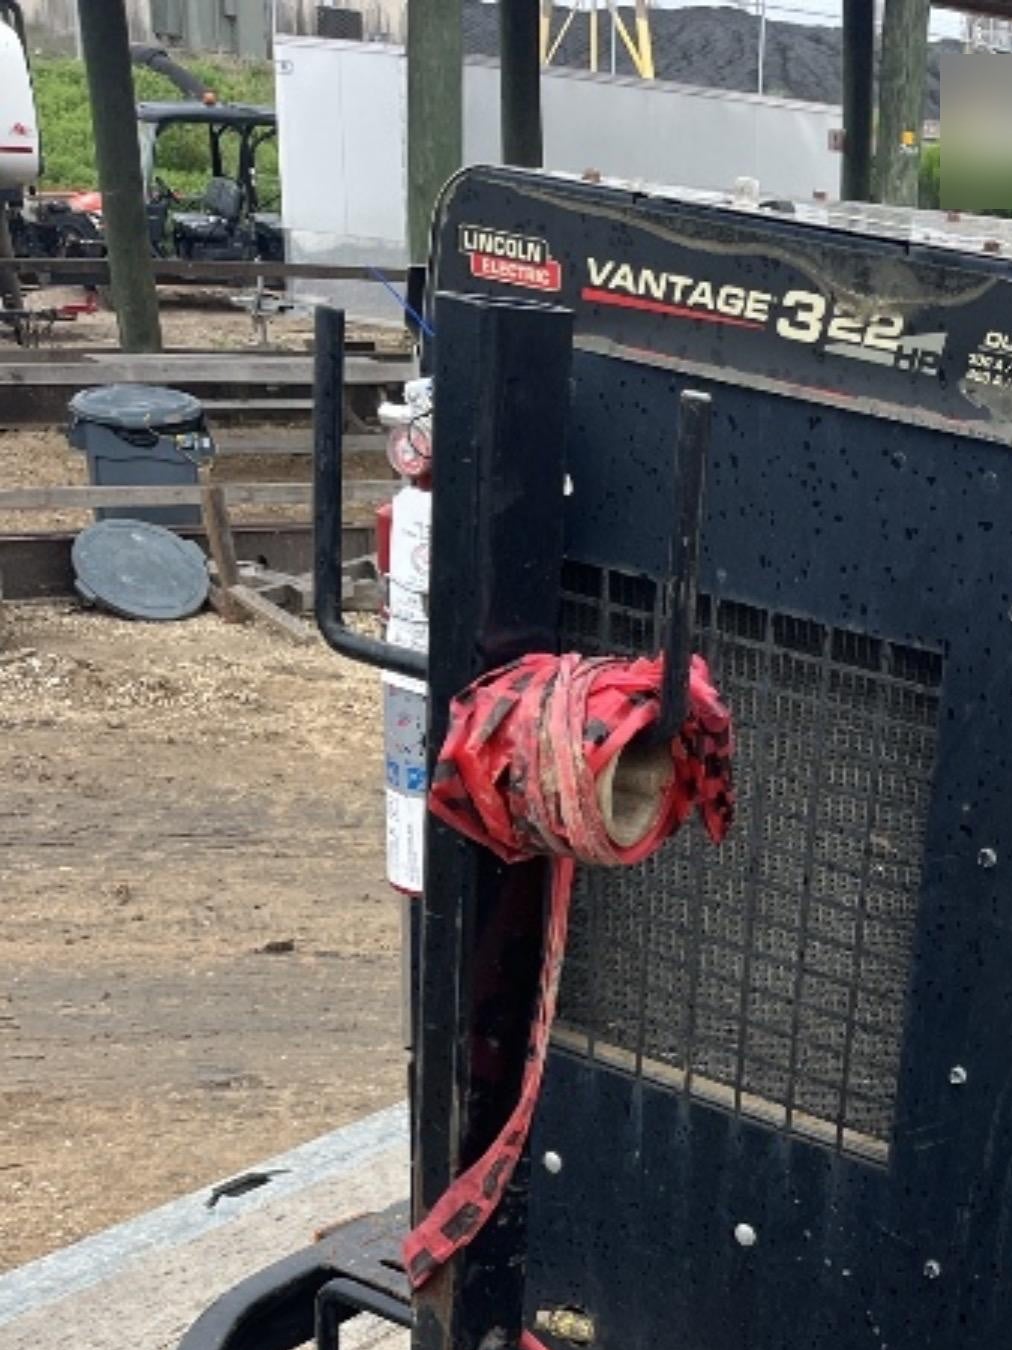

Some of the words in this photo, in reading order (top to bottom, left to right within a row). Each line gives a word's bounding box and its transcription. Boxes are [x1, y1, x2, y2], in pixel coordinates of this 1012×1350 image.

[463, 230, 542, 263] LINCOLN
[481, 256, 551, 285] ELECTRIC
[586, 256, 772, 322] VANTAGE
[776, 290, 904, 352] 322
